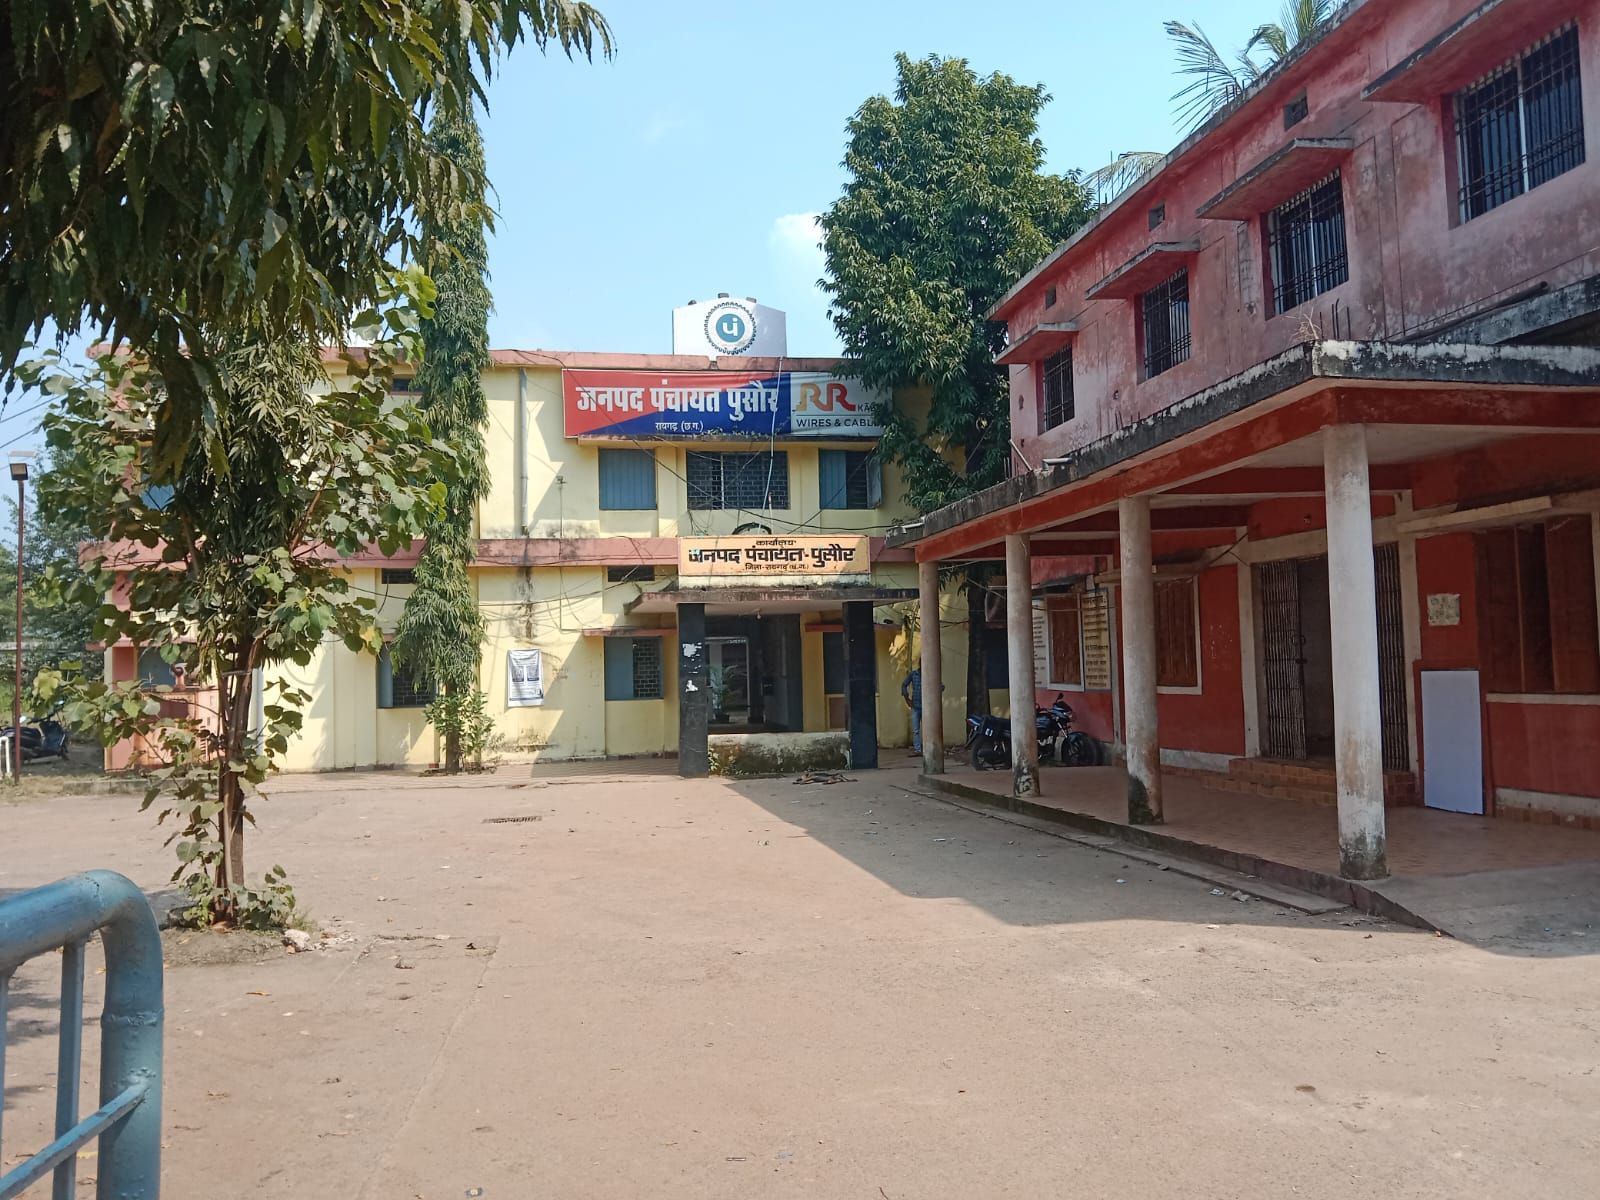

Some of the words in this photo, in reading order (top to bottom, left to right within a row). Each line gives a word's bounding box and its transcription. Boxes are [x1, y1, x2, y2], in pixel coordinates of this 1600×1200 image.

[576, 386, 645, 412] जनपद
[649, 379, 721, 412] पंचायत
[726, 380, 778, 421] पुसौर
[796, 383, 856, 412] RR
[796, 418, 831, 427] WIRES
[834, 418, 842, 427] &
[844, 418, 878, 427] CABL
[688, 548, 742, 564] जनपद
